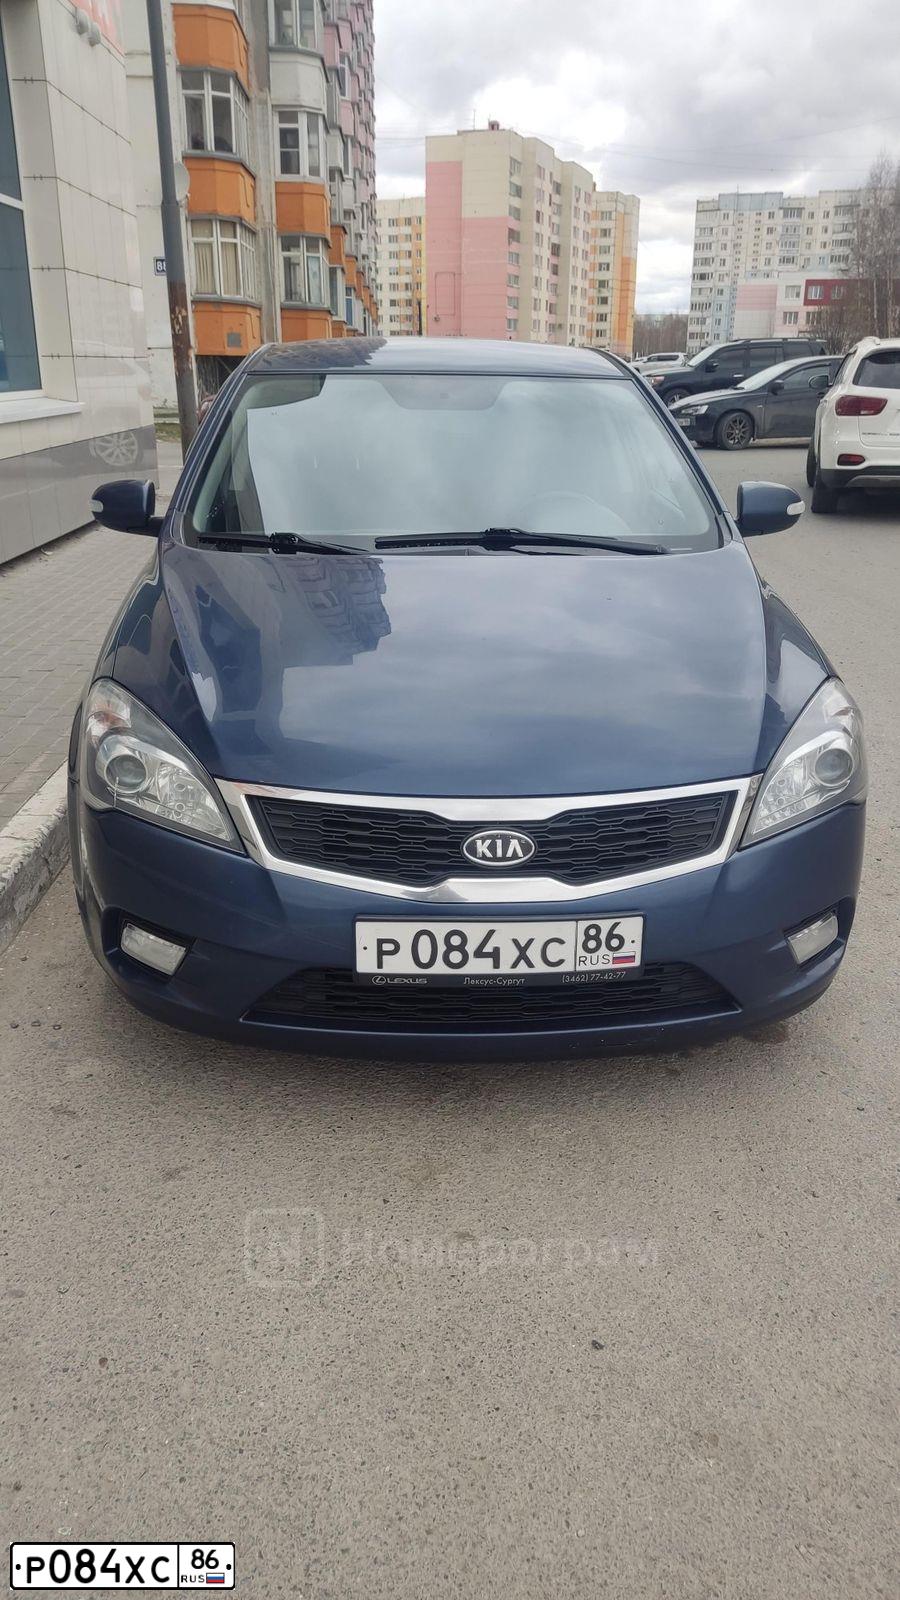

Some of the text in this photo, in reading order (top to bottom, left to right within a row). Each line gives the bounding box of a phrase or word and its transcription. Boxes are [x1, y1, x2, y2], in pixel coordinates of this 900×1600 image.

[475, 839, 524, 858] KIA
[581, 922, 625, 954] 86
[578, 954, 611, 967] RUS
[562, 971, 626, 984] (3462) 77-42-77
